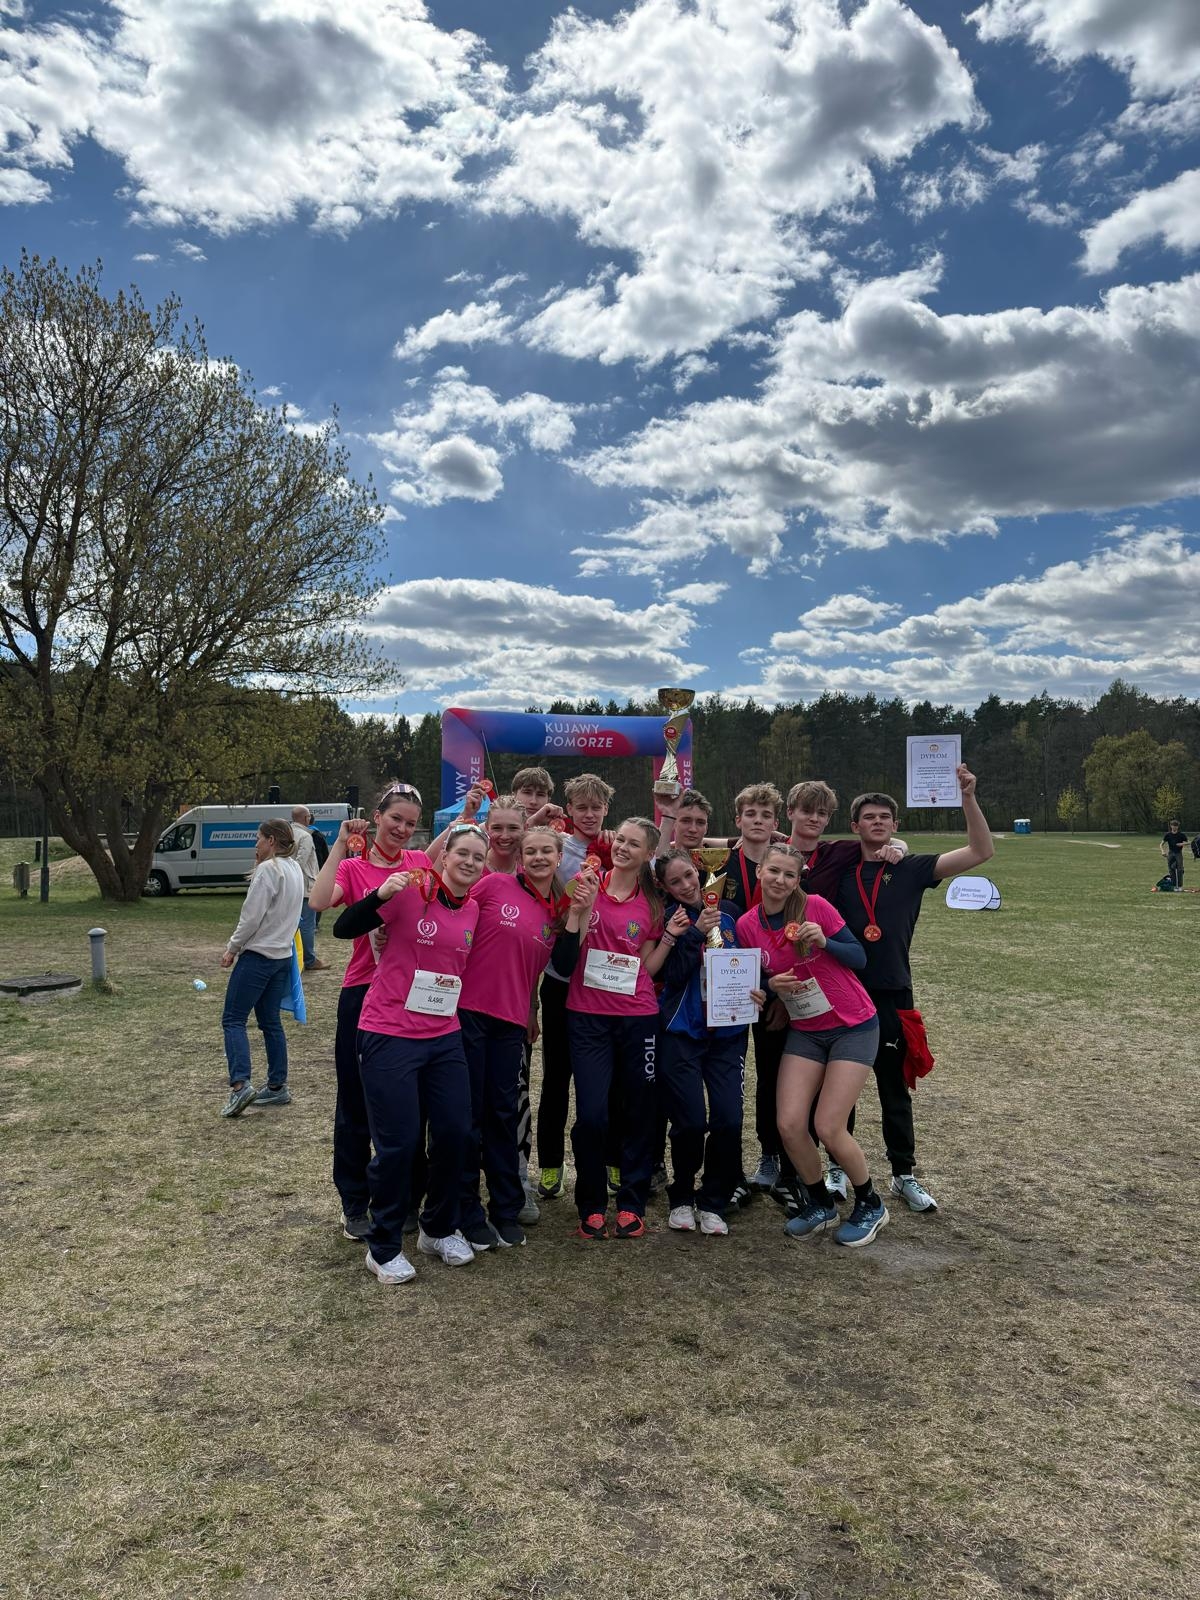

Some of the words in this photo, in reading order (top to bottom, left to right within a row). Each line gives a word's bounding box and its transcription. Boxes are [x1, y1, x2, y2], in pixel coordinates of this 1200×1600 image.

[544, 722, 600, 734] KUJAWY
[544, 735, 614, 748] POMORZE
[416, 938, 435, 946] KOPER
